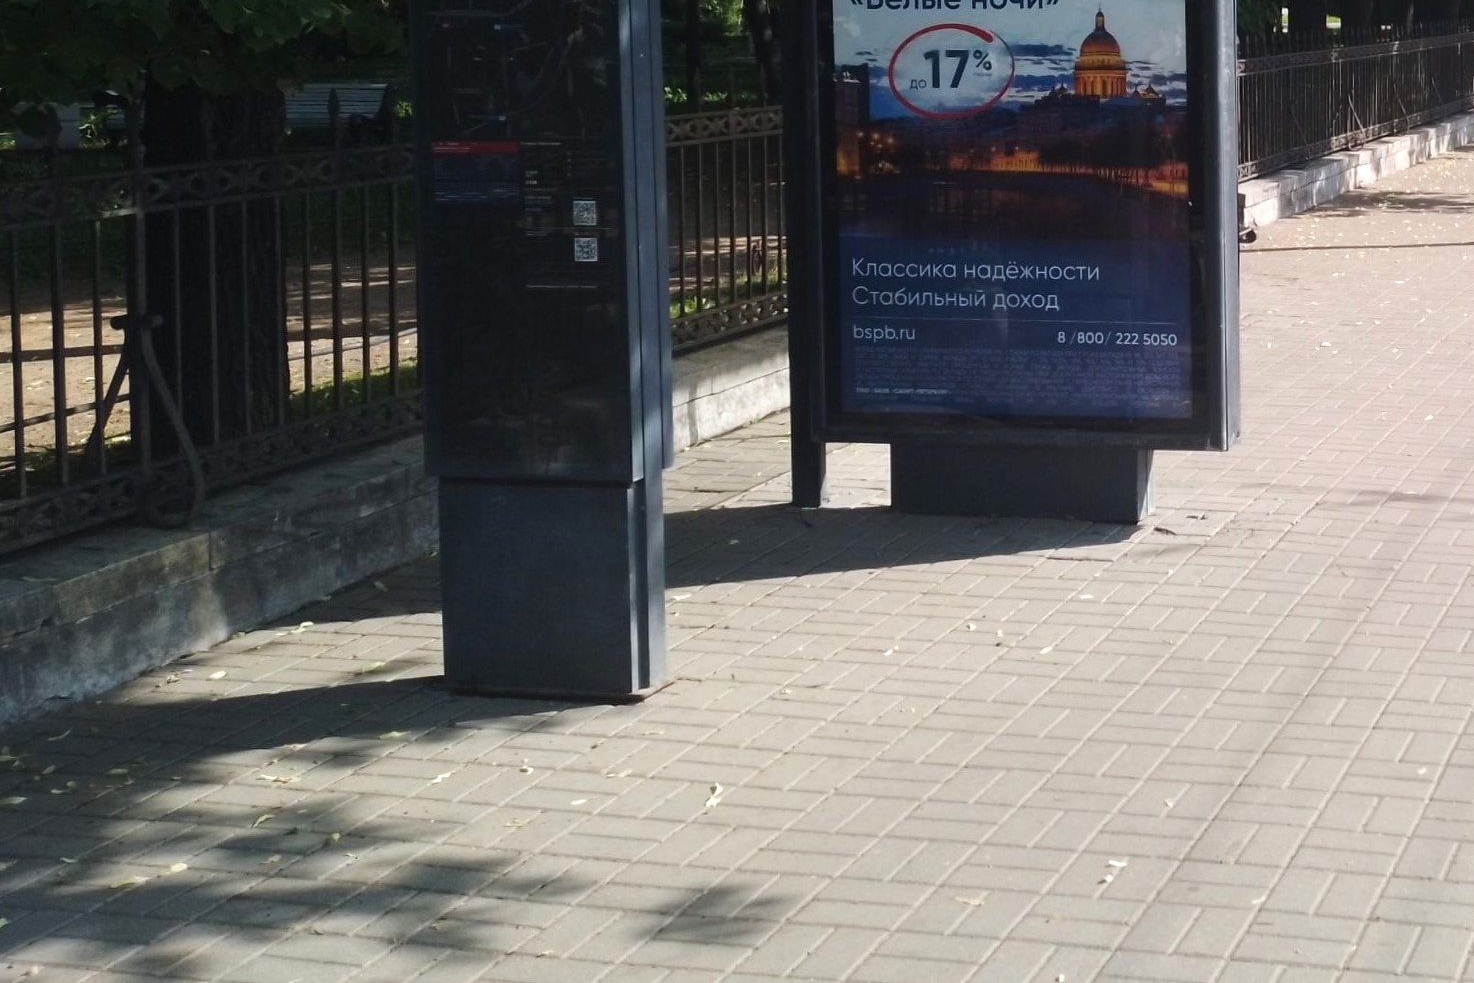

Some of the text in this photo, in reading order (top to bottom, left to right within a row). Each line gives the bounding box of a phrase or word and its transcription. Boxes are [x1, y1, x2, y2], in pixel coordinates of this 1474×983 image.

[909, 49, 993, 90] до 17%
[852, 257, 1100, 282] Классика надёжности
[852, 285, 1059, 311] Стабильный доход
[853, 324, 916, 342] bspb.ru
[1057, 331, 1066, 344] 8
[1115, 333, 1139, 346] 222
[1143, 333, 1178, 347] 5050
